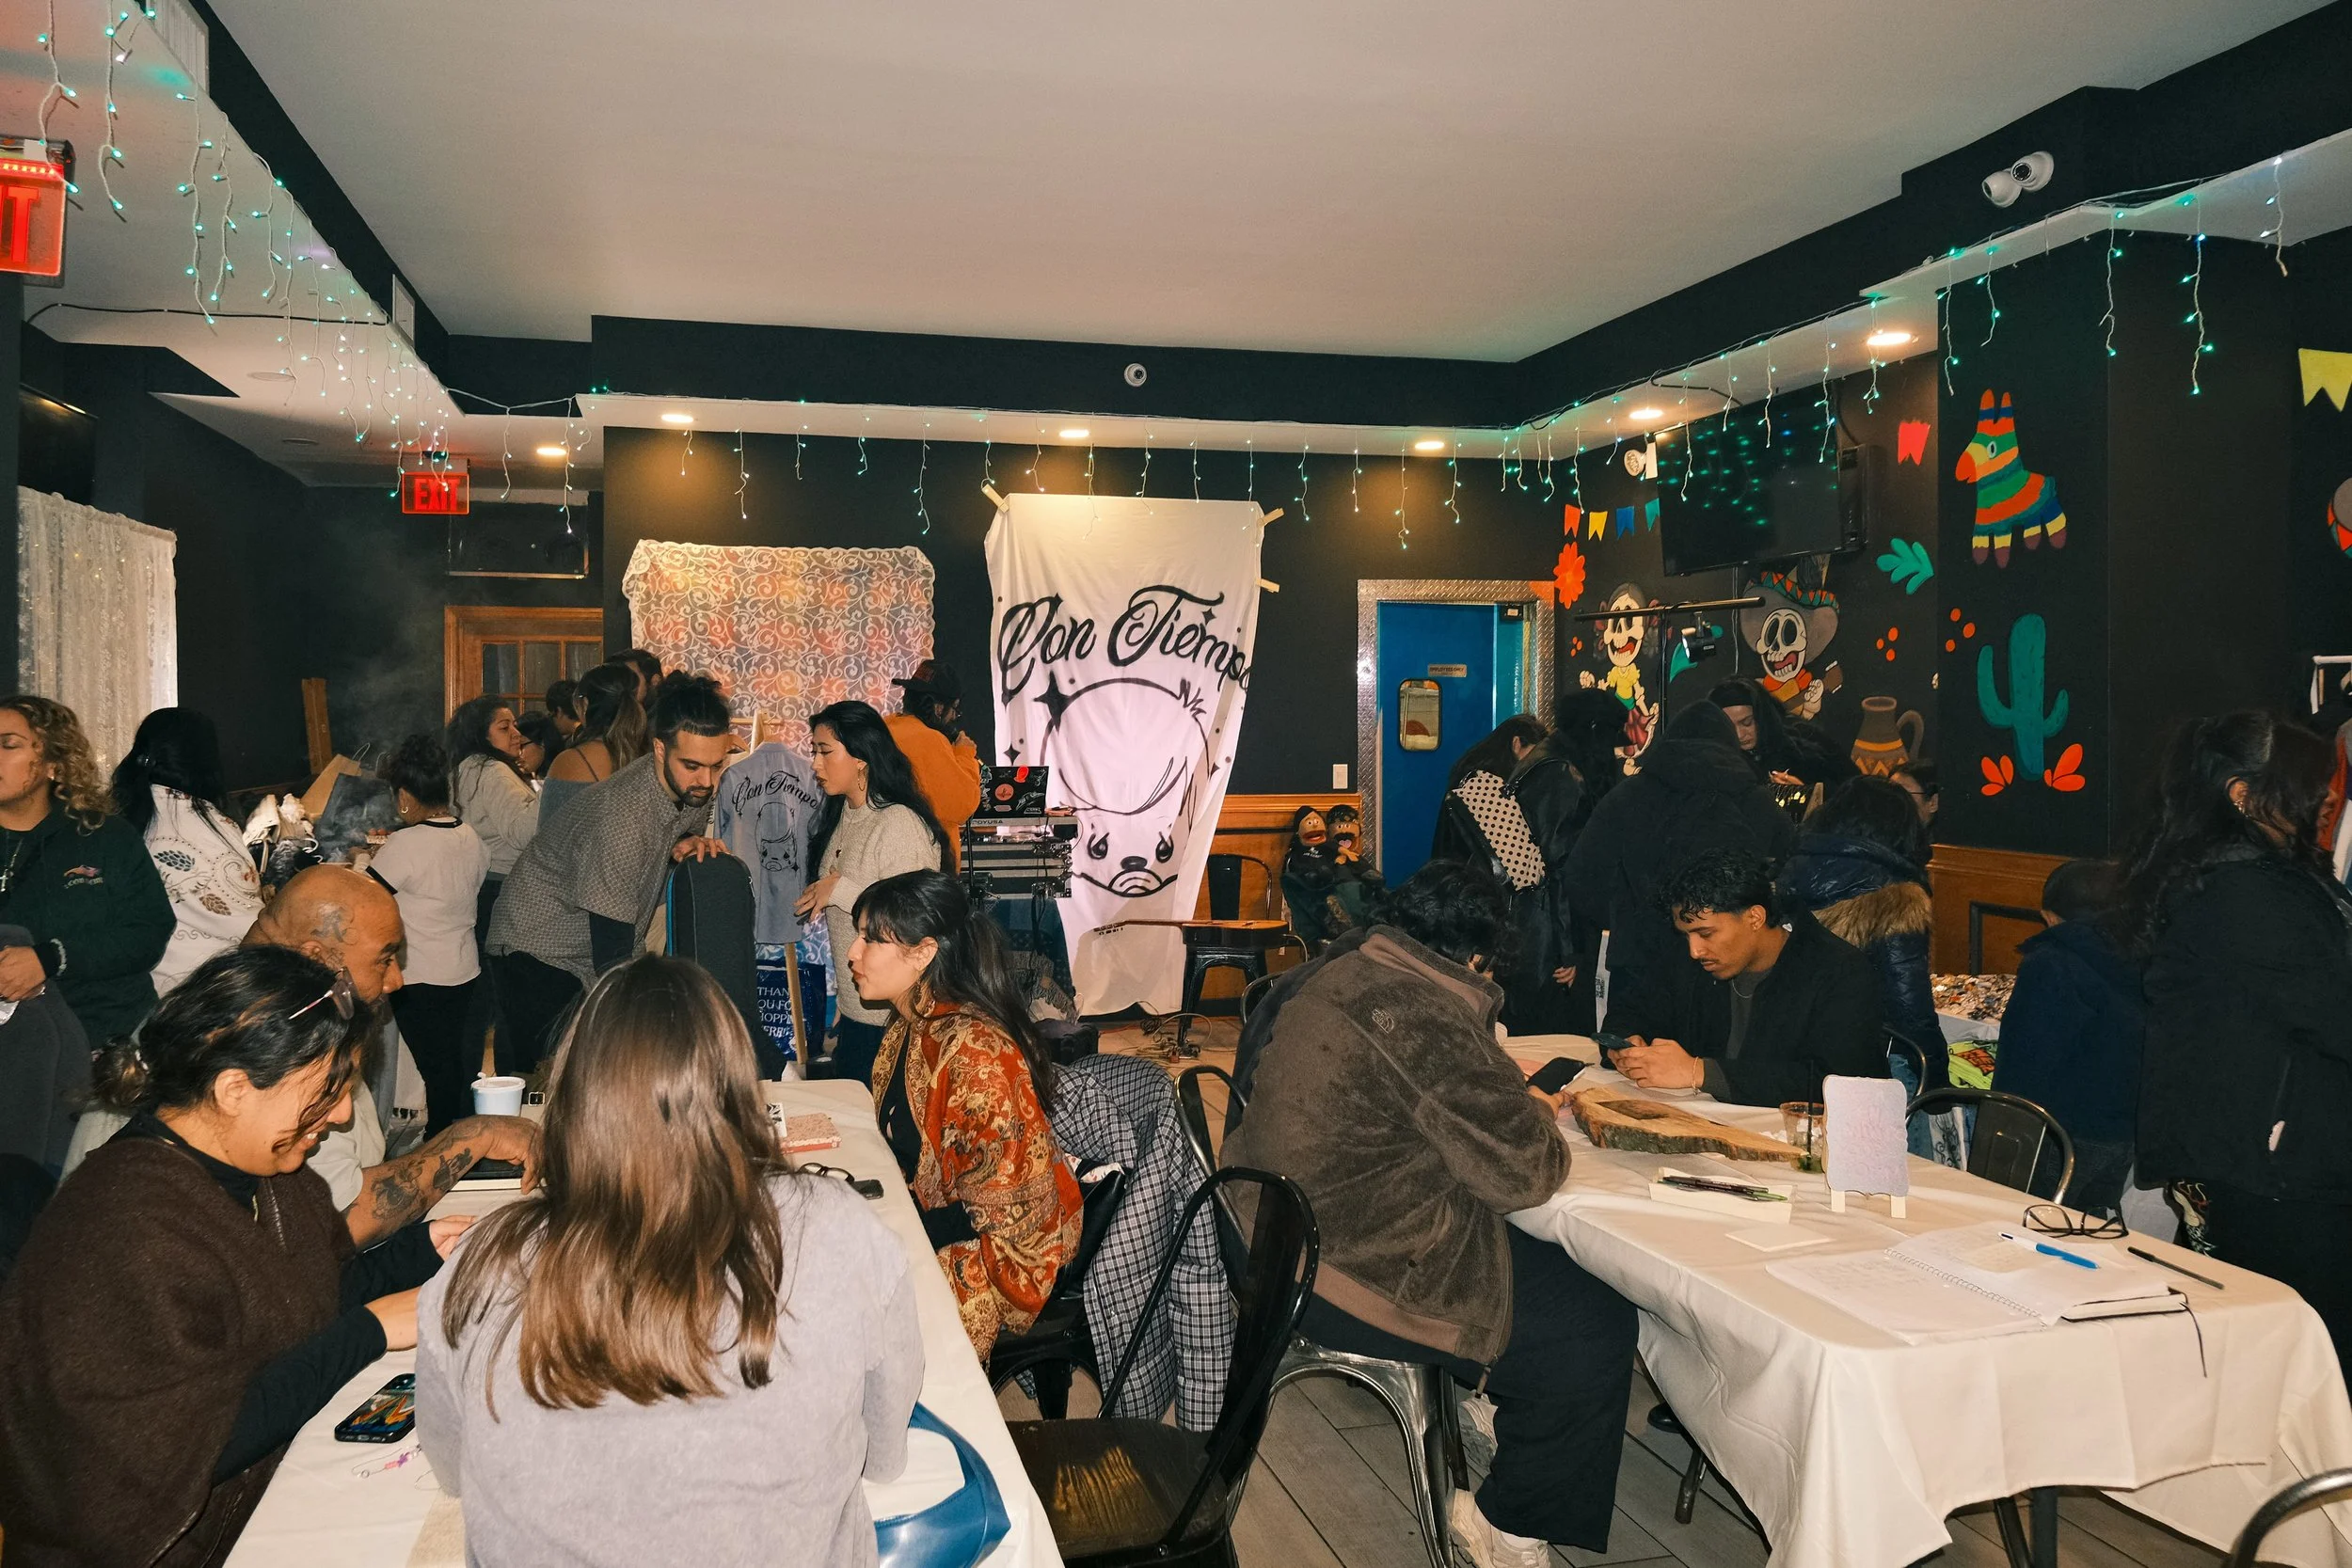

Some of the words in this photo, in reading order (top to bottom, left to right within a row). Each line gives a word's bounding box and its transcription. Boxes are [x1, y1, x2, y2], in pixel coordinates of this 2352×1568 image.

[414, 478, 461, 511] EXIT
[997, 593, 1098, 707] Con
[732, 775, 764, 816] Con
[756, 986, 790, 998] THAN
[757, 999, 776, 1010] OU
[778, 1000, 793, 1011] FO
